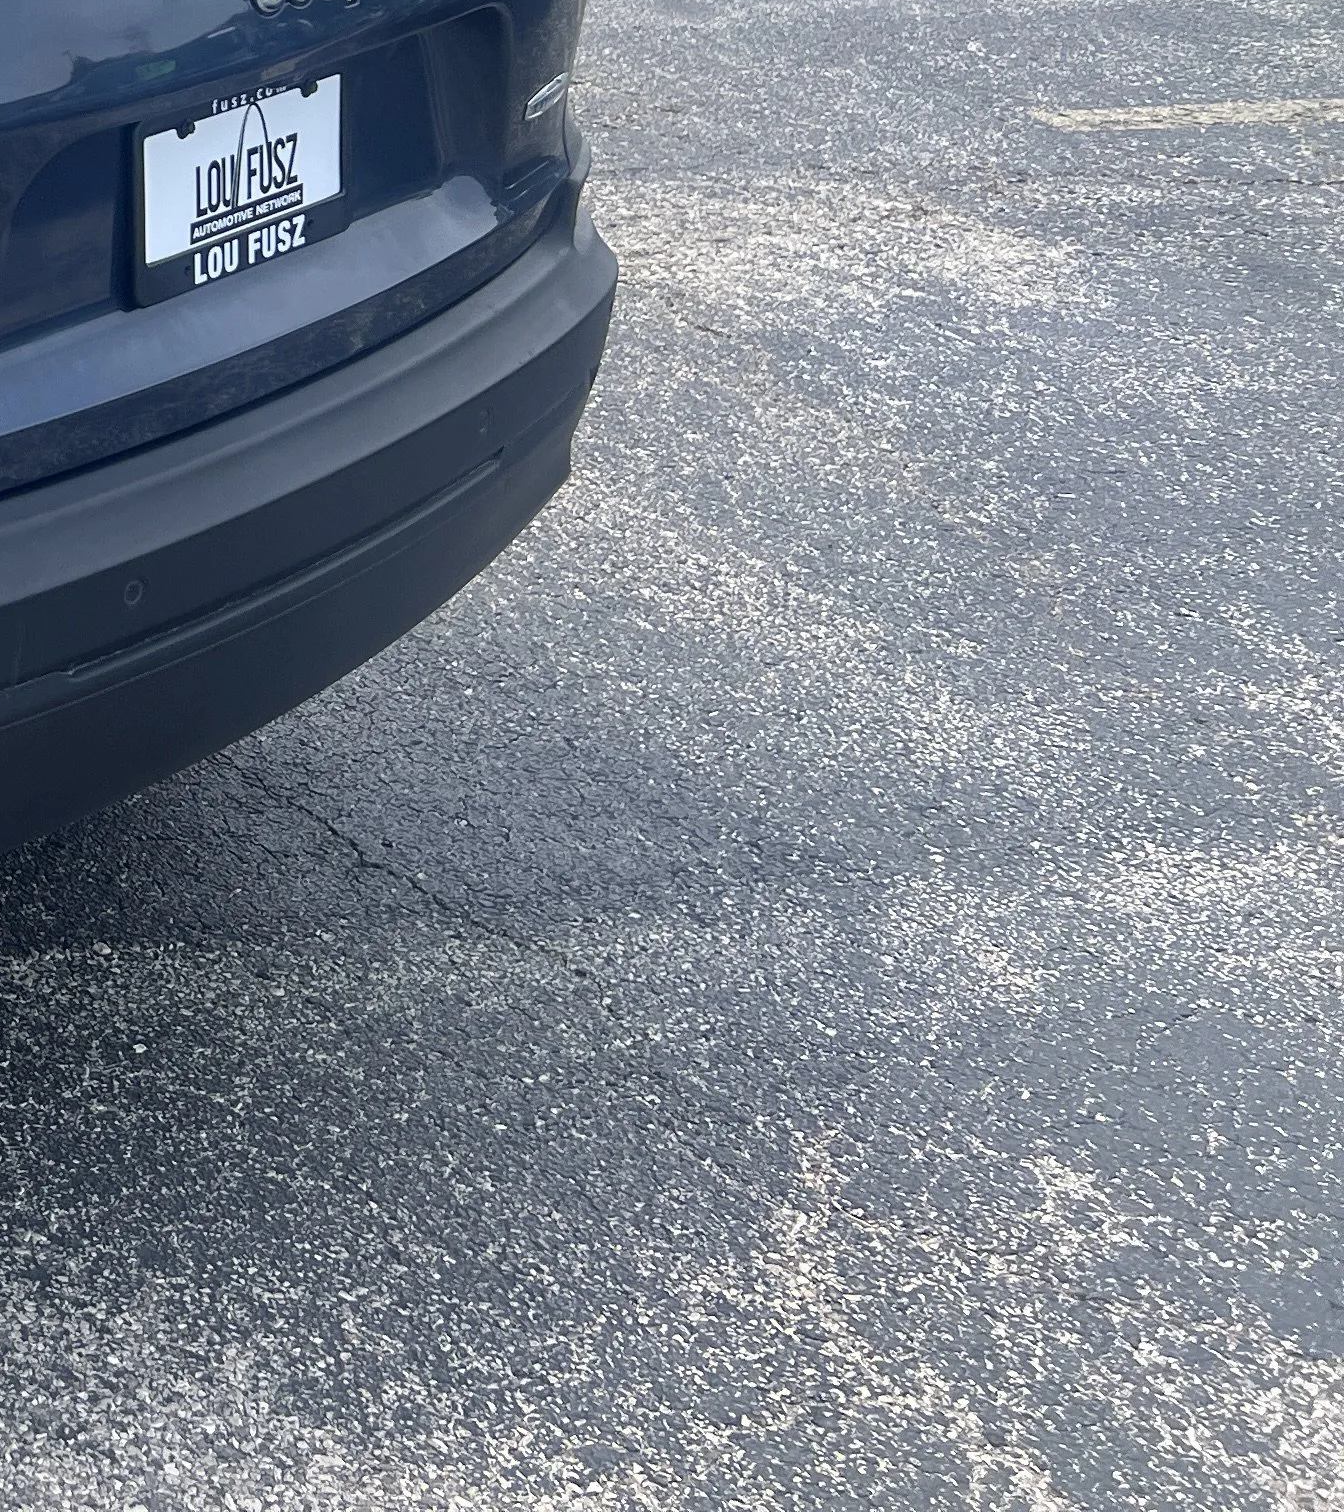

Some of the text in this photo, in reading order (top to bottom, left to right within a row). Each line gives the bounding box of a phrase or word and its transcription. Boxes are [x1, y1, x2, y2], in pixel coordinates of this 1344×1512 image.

[196, 132, 298, 218] LOU FUSZ
[193, 189, 302, 239] AUTOMOTIVE NETWORK
[194, 213, 306, 285] LOU FUSZ
